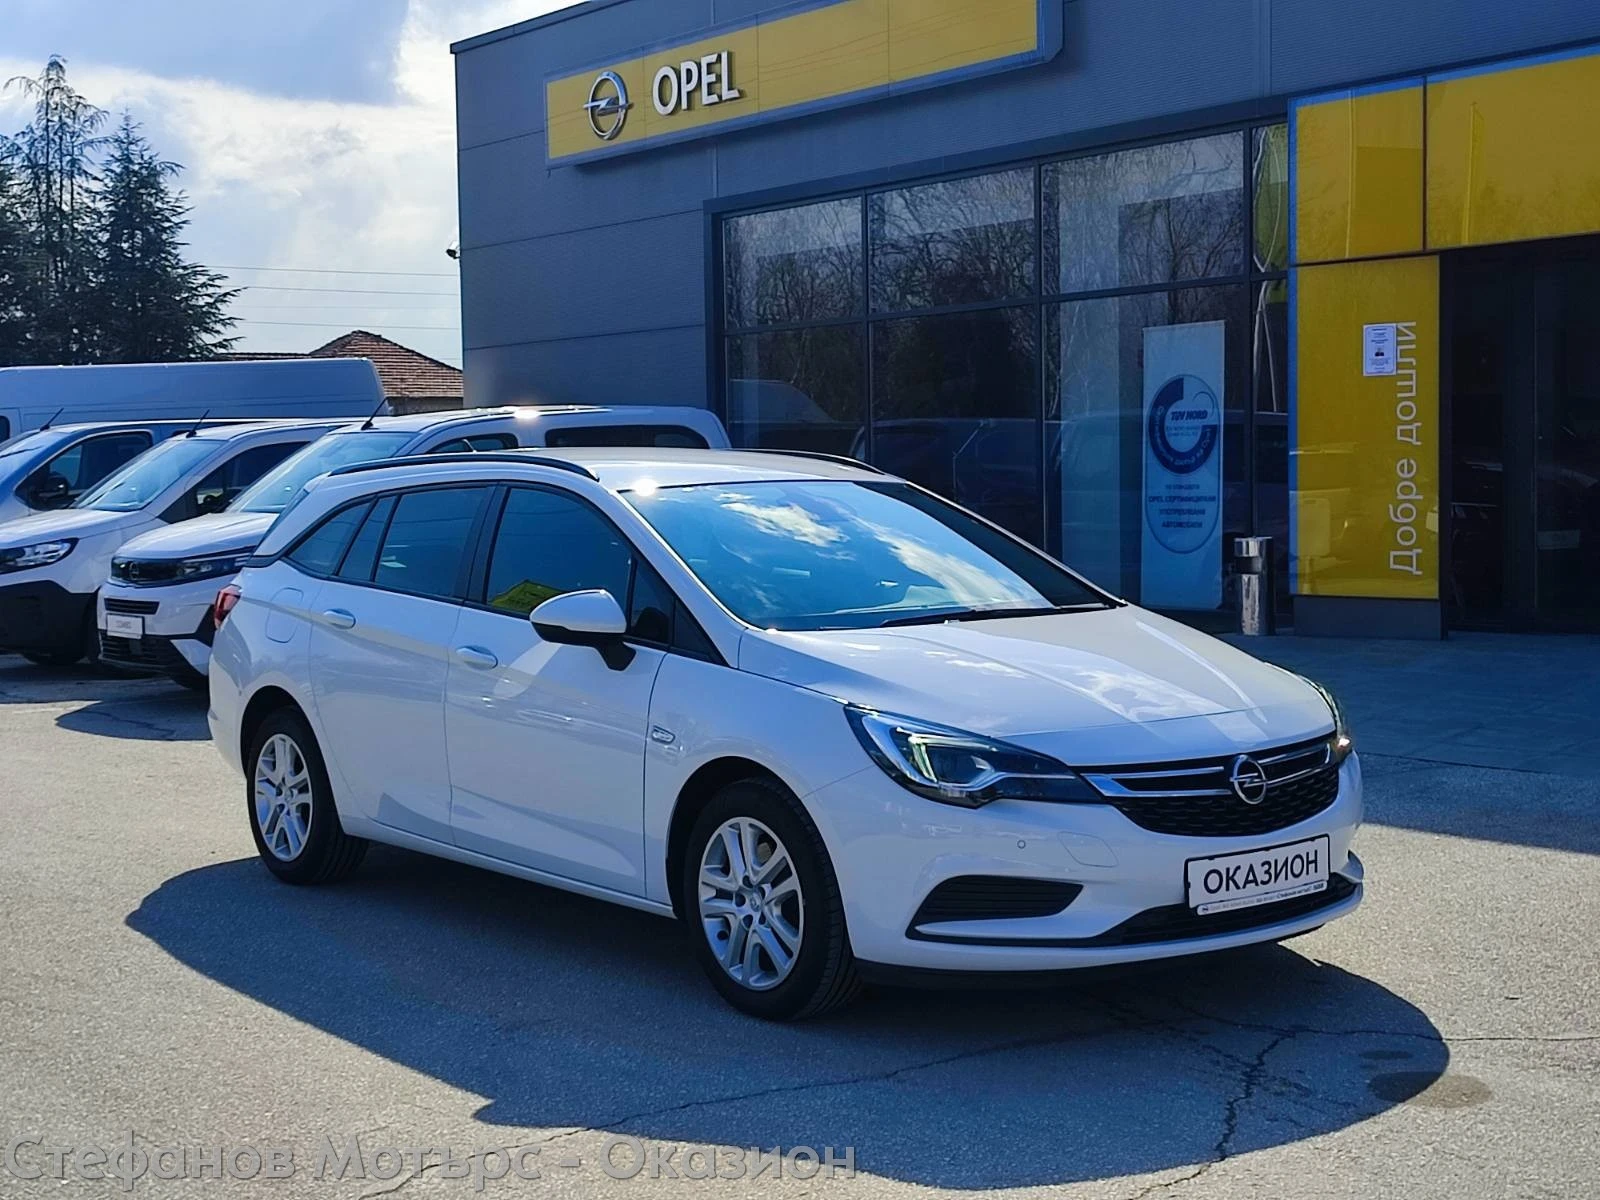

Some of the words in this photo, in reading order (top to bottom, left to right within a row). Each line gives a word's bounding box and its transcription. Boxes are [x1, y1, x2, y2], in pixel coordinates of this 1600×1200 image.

[652, 51, 740, 116] OPEL
[1396, 321, 1421, 445] дошли
[1389, 457, 1423, 576] Добре
[1203, 849, 1319, 895] ОКАЗИОН
